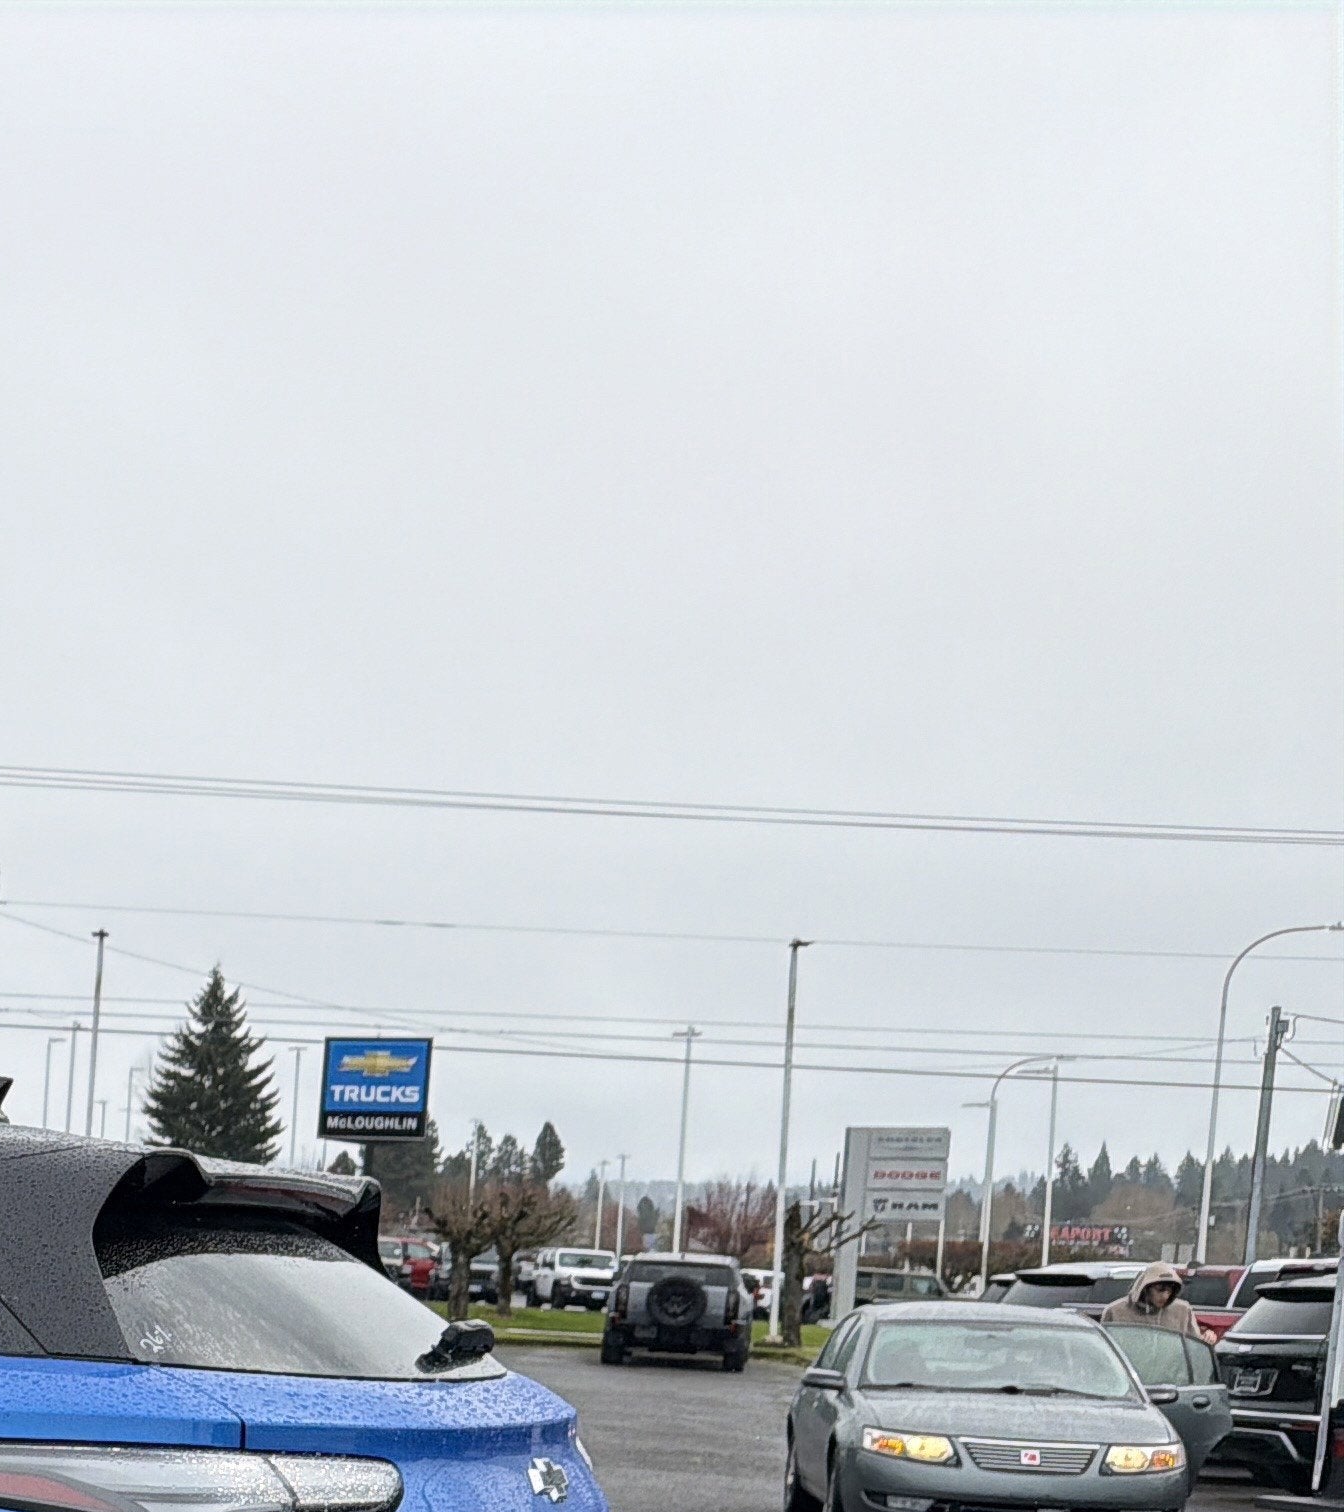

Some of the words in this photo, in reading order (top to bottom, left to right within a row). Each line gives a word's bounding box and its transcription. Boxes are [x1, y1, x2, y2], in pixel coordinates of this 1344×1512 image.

[330, 1085, 420, 1103] TRUCKS
[326, 1115, 418, 1131] McLOUGHLIN
[873, 1170, 941, 1180] DODGE
[891, 1202, 939, 1211] RAM
